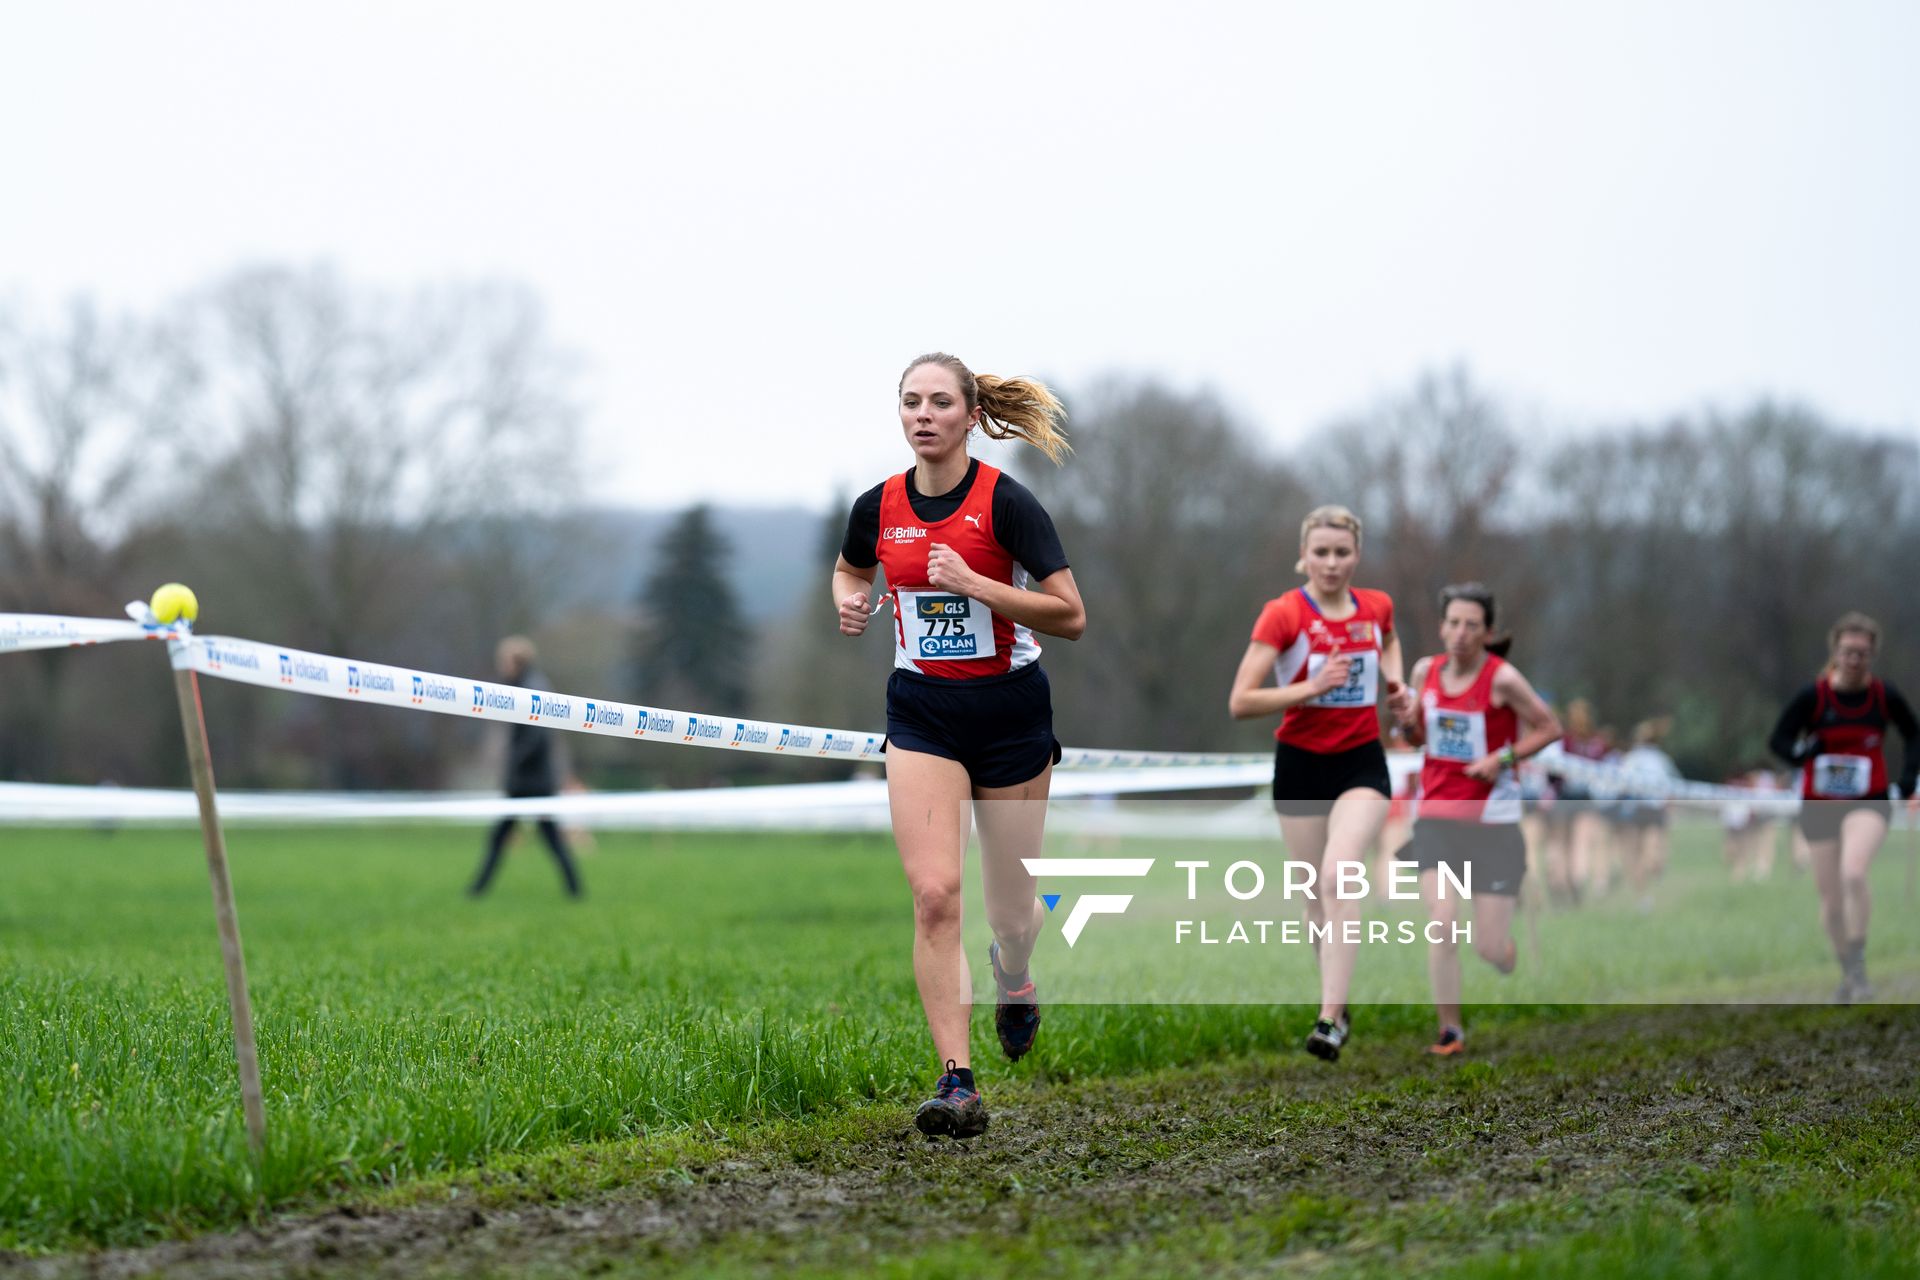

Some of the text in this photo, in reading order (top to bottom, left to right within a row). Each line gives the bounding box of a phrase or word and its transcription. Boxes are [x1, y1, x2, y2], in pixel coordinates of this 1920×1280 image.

[895, 526, 927, 539] Brillux
[944, 602, 965, 614] GLS
[924, 618, 966, 637] 775
[941, 638, 974, 649] PLAN
[424, 678, 456, 702] Volksbank
[486, 688, 515, 711] Volksbank
[542, 696, 571, 720] Volksbank
[596, 704, 624, 727] Volksbank
[647, 712, 674, 734] Volksbank
[697, 719, 722, 739] Volksbank
